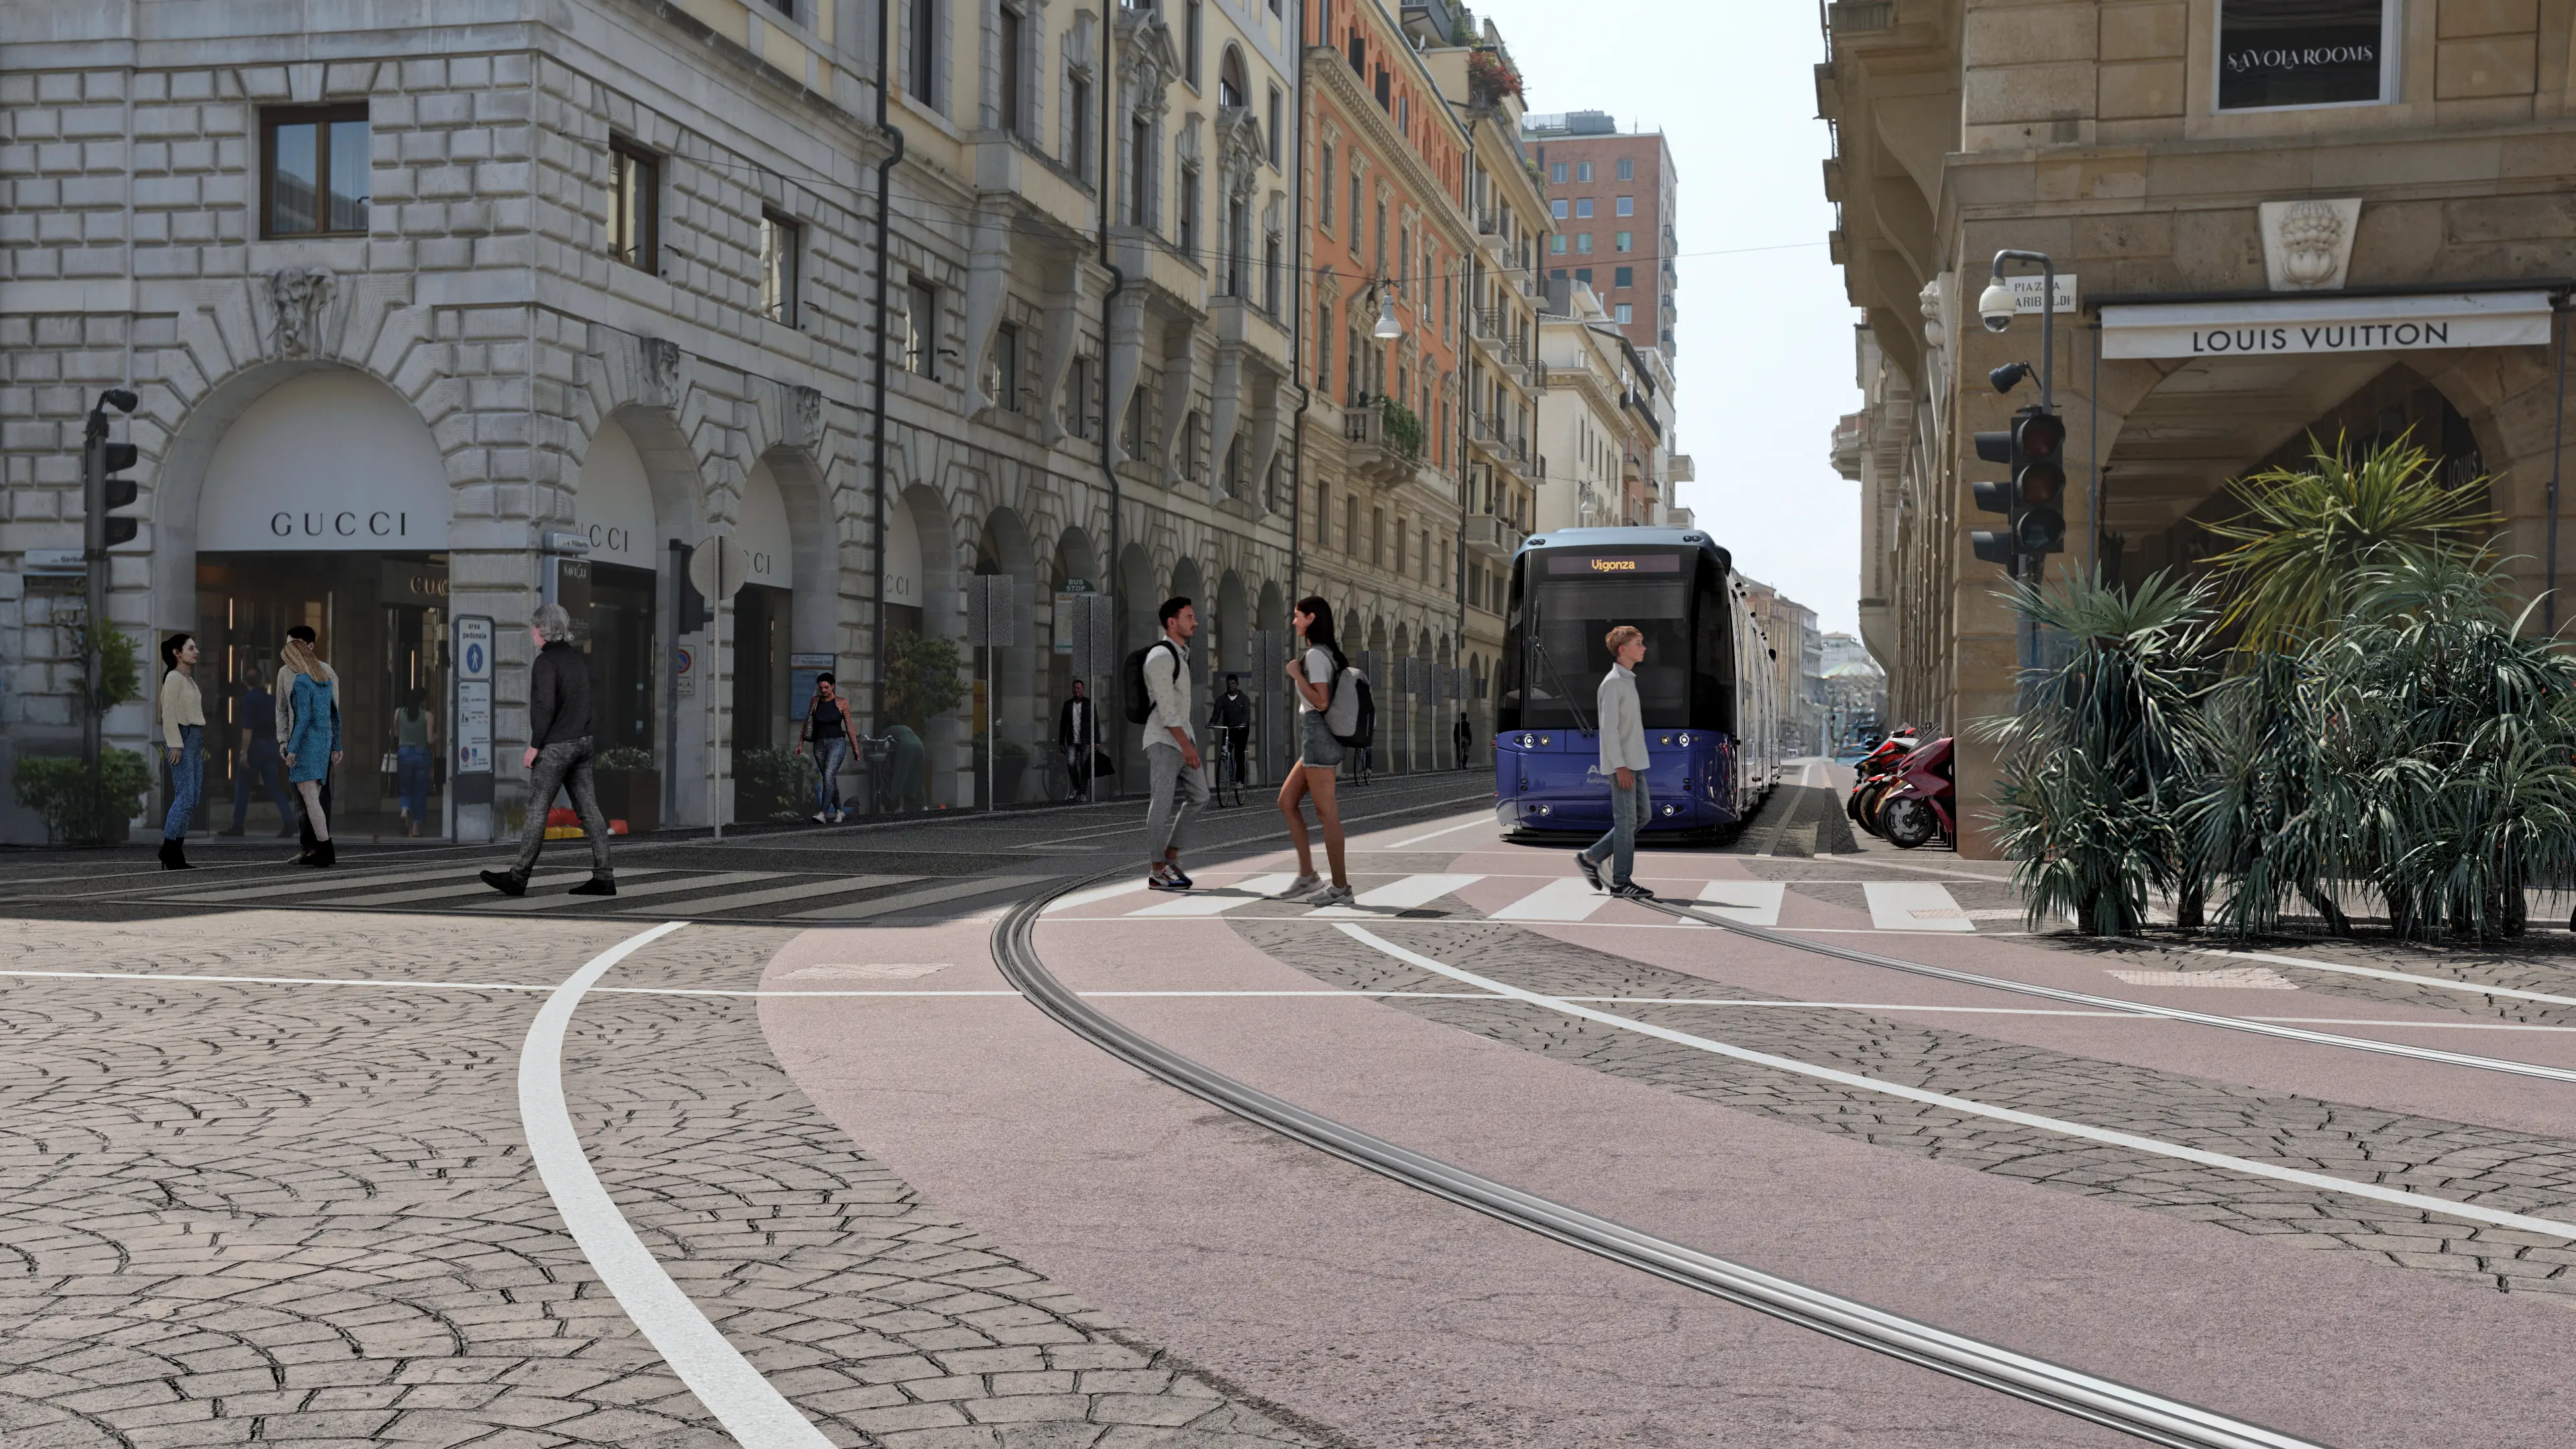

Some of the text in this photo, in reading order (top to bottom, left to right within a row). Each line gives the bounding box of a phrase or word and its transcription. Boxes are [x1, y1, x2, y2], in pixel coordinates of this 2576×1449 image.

[2227, 44, 2373, 72] SAVOIA ROOMS
[2015, 281, 2061, 292] PIAZA
[2015, 295, 2070, 307] ARIBLDI
[2194, 323, 2447, 352] LOUIS VUITTON
[271, 512, 406, 537] GUCCI
[581, 523, 628, 552] CCI
[1591, 559, 1635, 572] Vigonza
[410, 575, 449, 597] GUC
